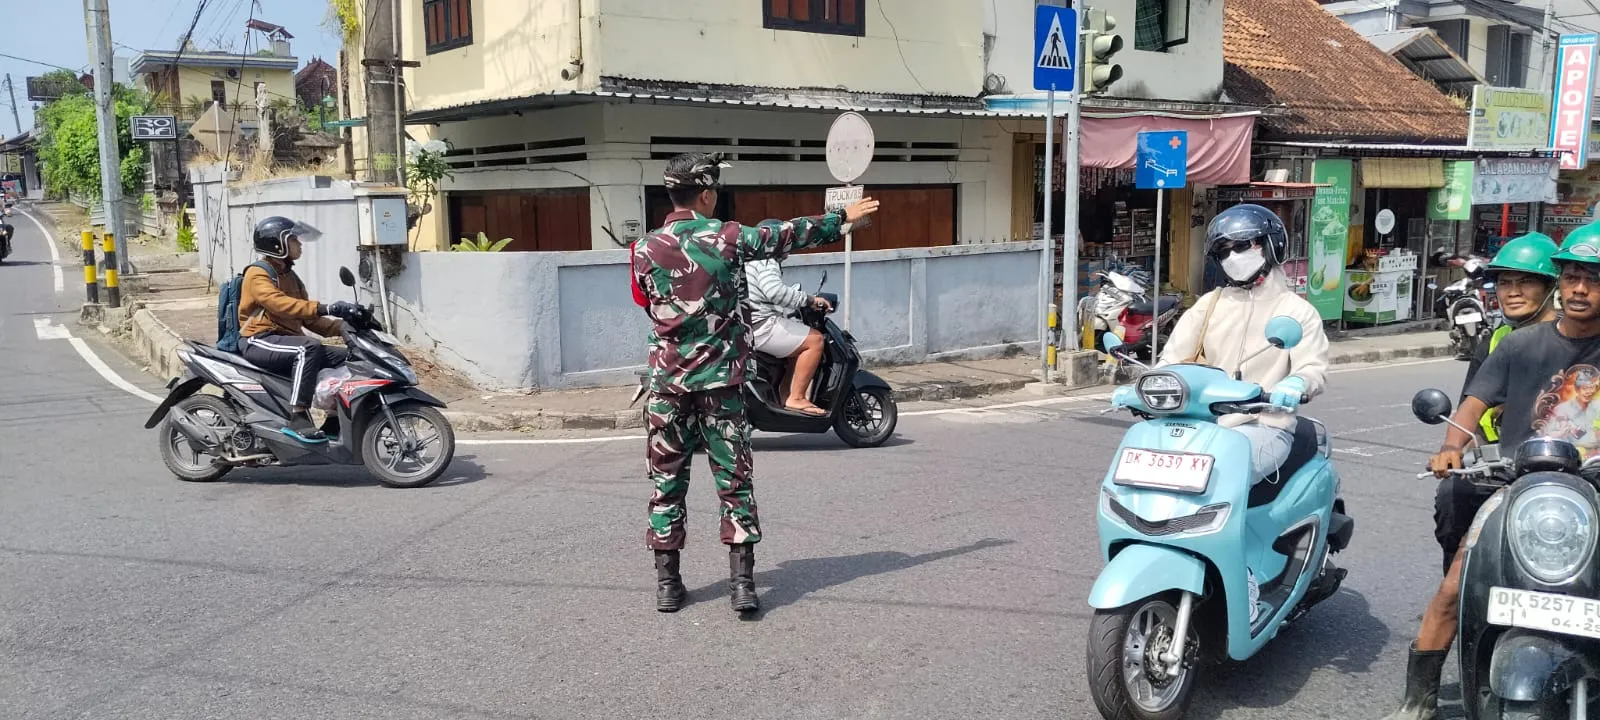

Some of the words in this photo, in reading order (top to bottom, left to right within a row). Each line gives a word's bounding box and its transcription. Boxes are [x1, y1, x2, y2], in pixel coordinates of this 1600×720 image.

[1560, 48, 1587, 166] APOTEK
[1125, 452, 1142, 464] DK
[1497, 591, 1522, 608] DK
[1529, 594, 1575, 613] 5257
